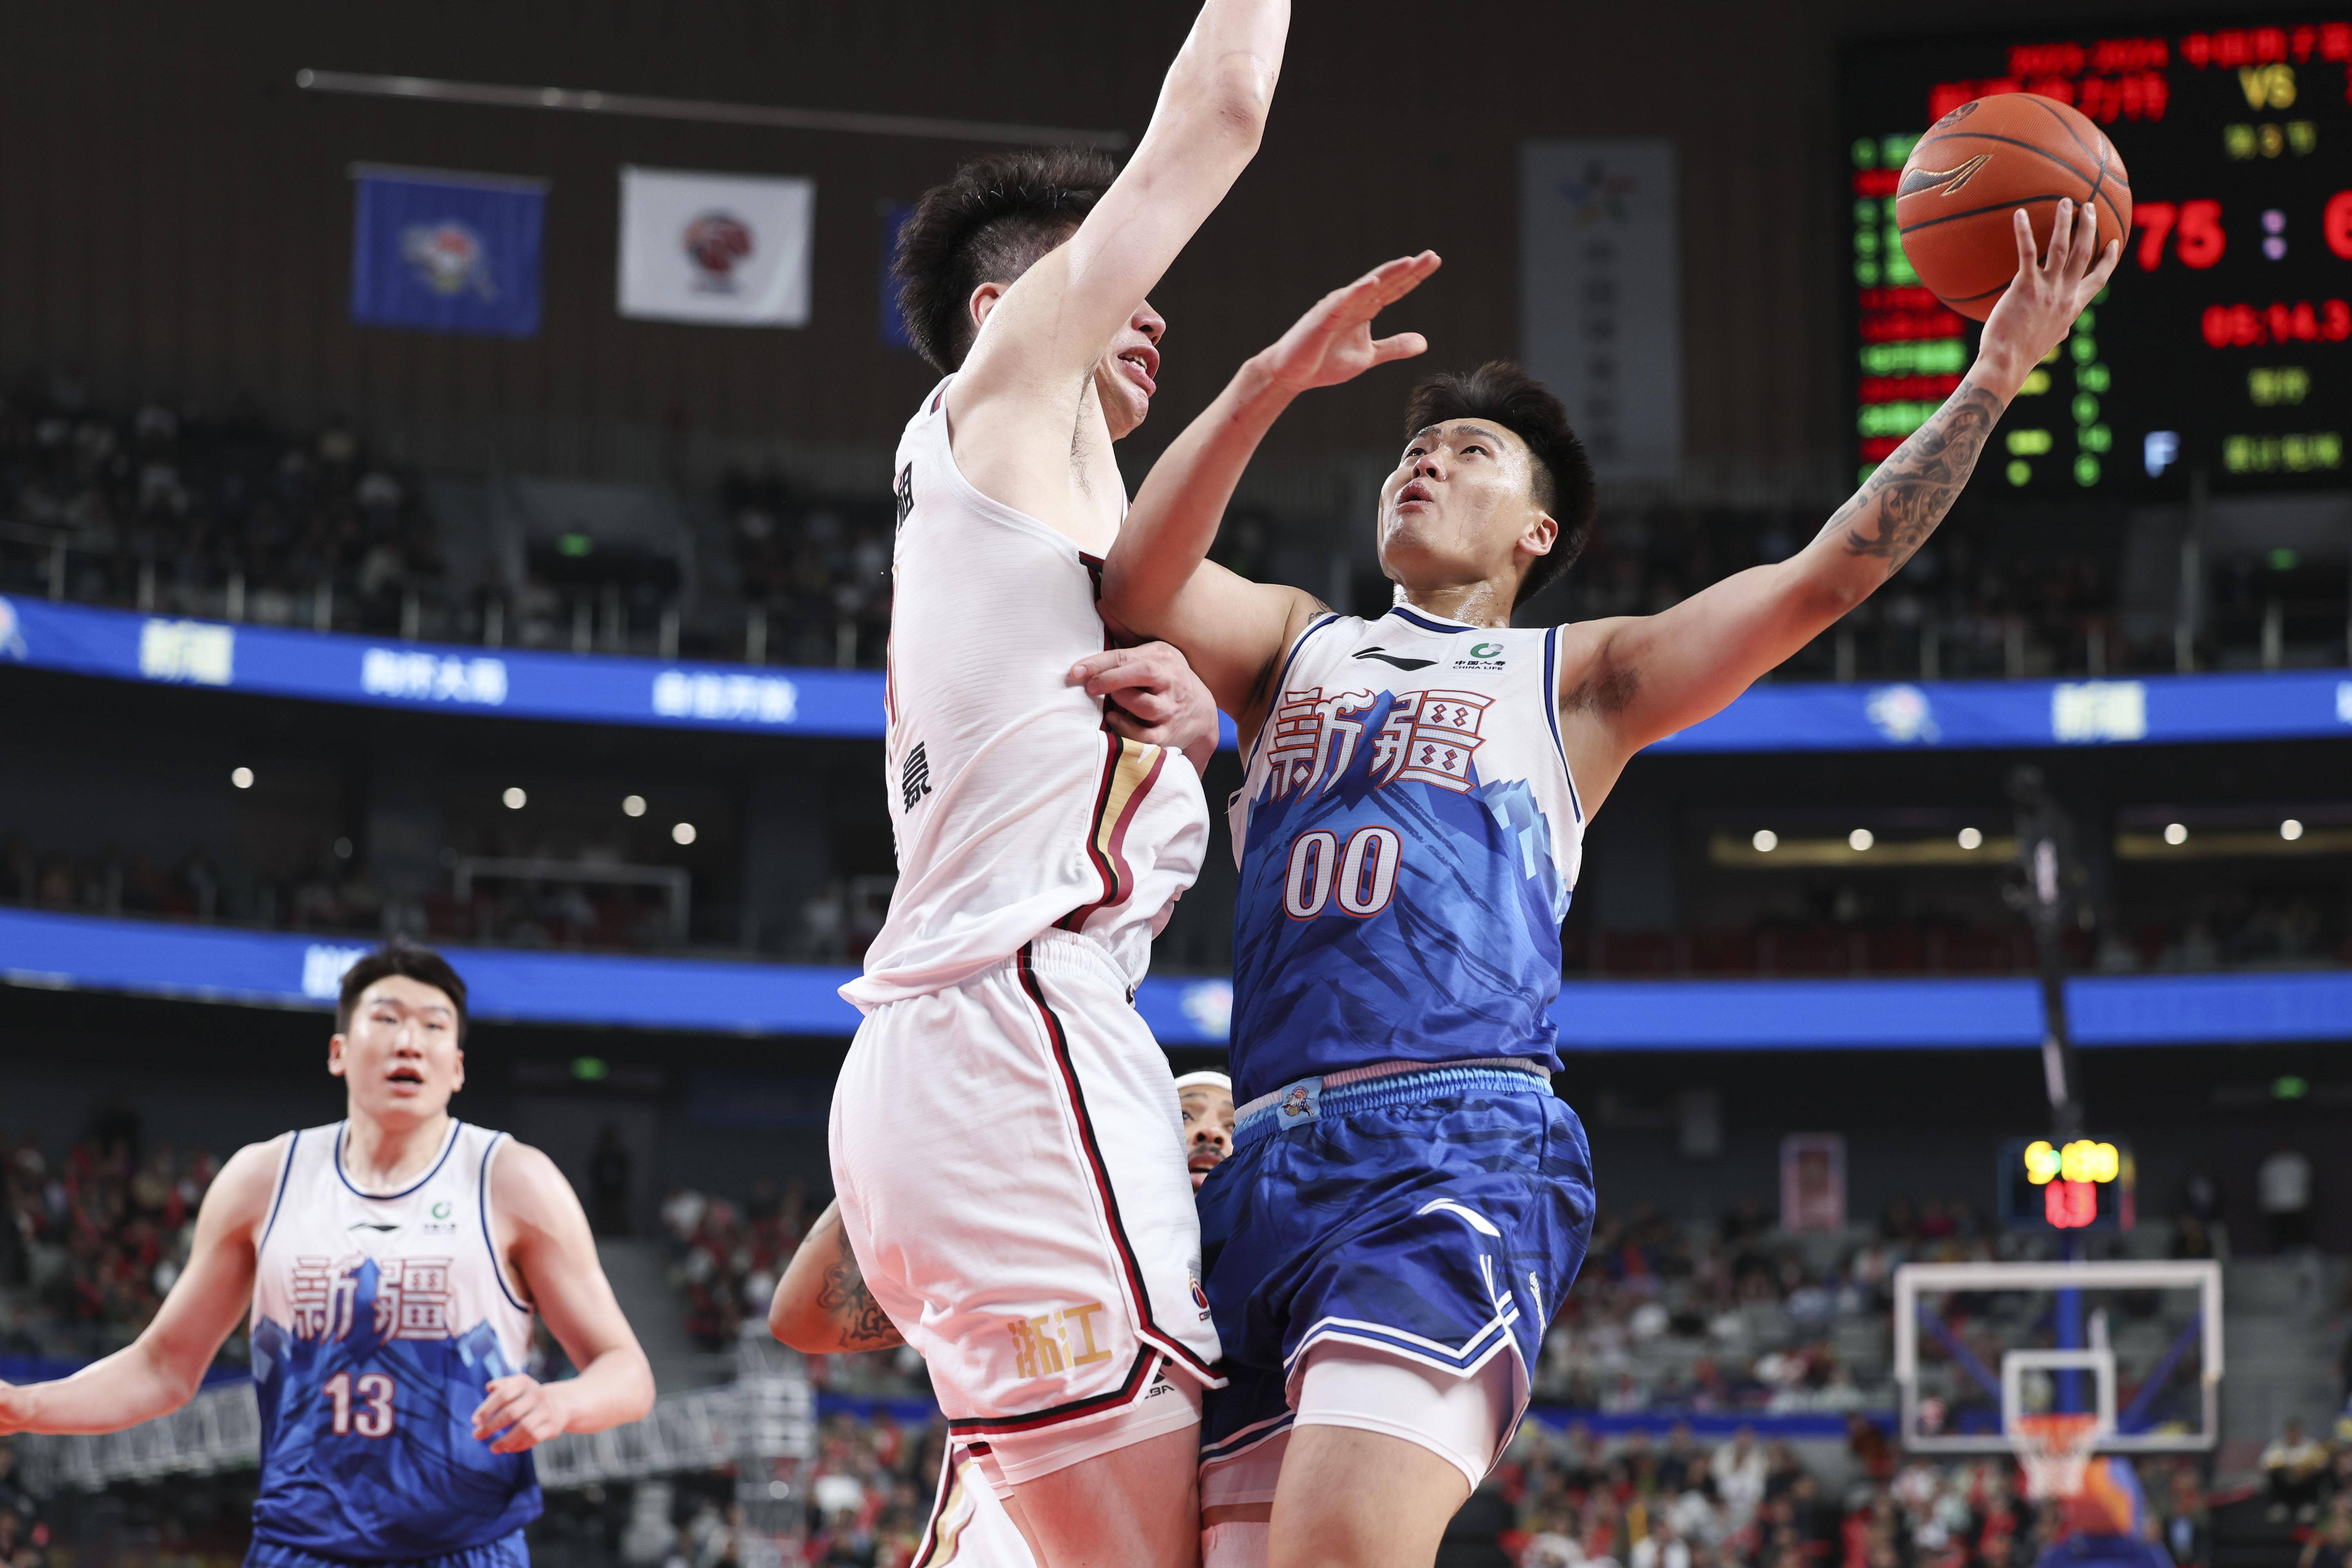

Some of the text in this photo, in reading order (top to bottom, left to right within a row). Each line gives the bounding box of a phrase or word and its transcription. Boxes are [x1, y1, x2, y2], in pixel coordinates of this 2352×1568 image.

[2239, 64, 2297, 110] VS
[2133, 199, 2227, 272] 75
[1267, 686, 1496, 805] 新疆
[1283, 825, 1403, 921] 00
[292, 1250, 453, 1346] 新疆
[1007, 1302, 1112, 1379] 浙江
[321, 1371, 397, 1439] 13
[1145, 1385, 1175, 1399] BA
